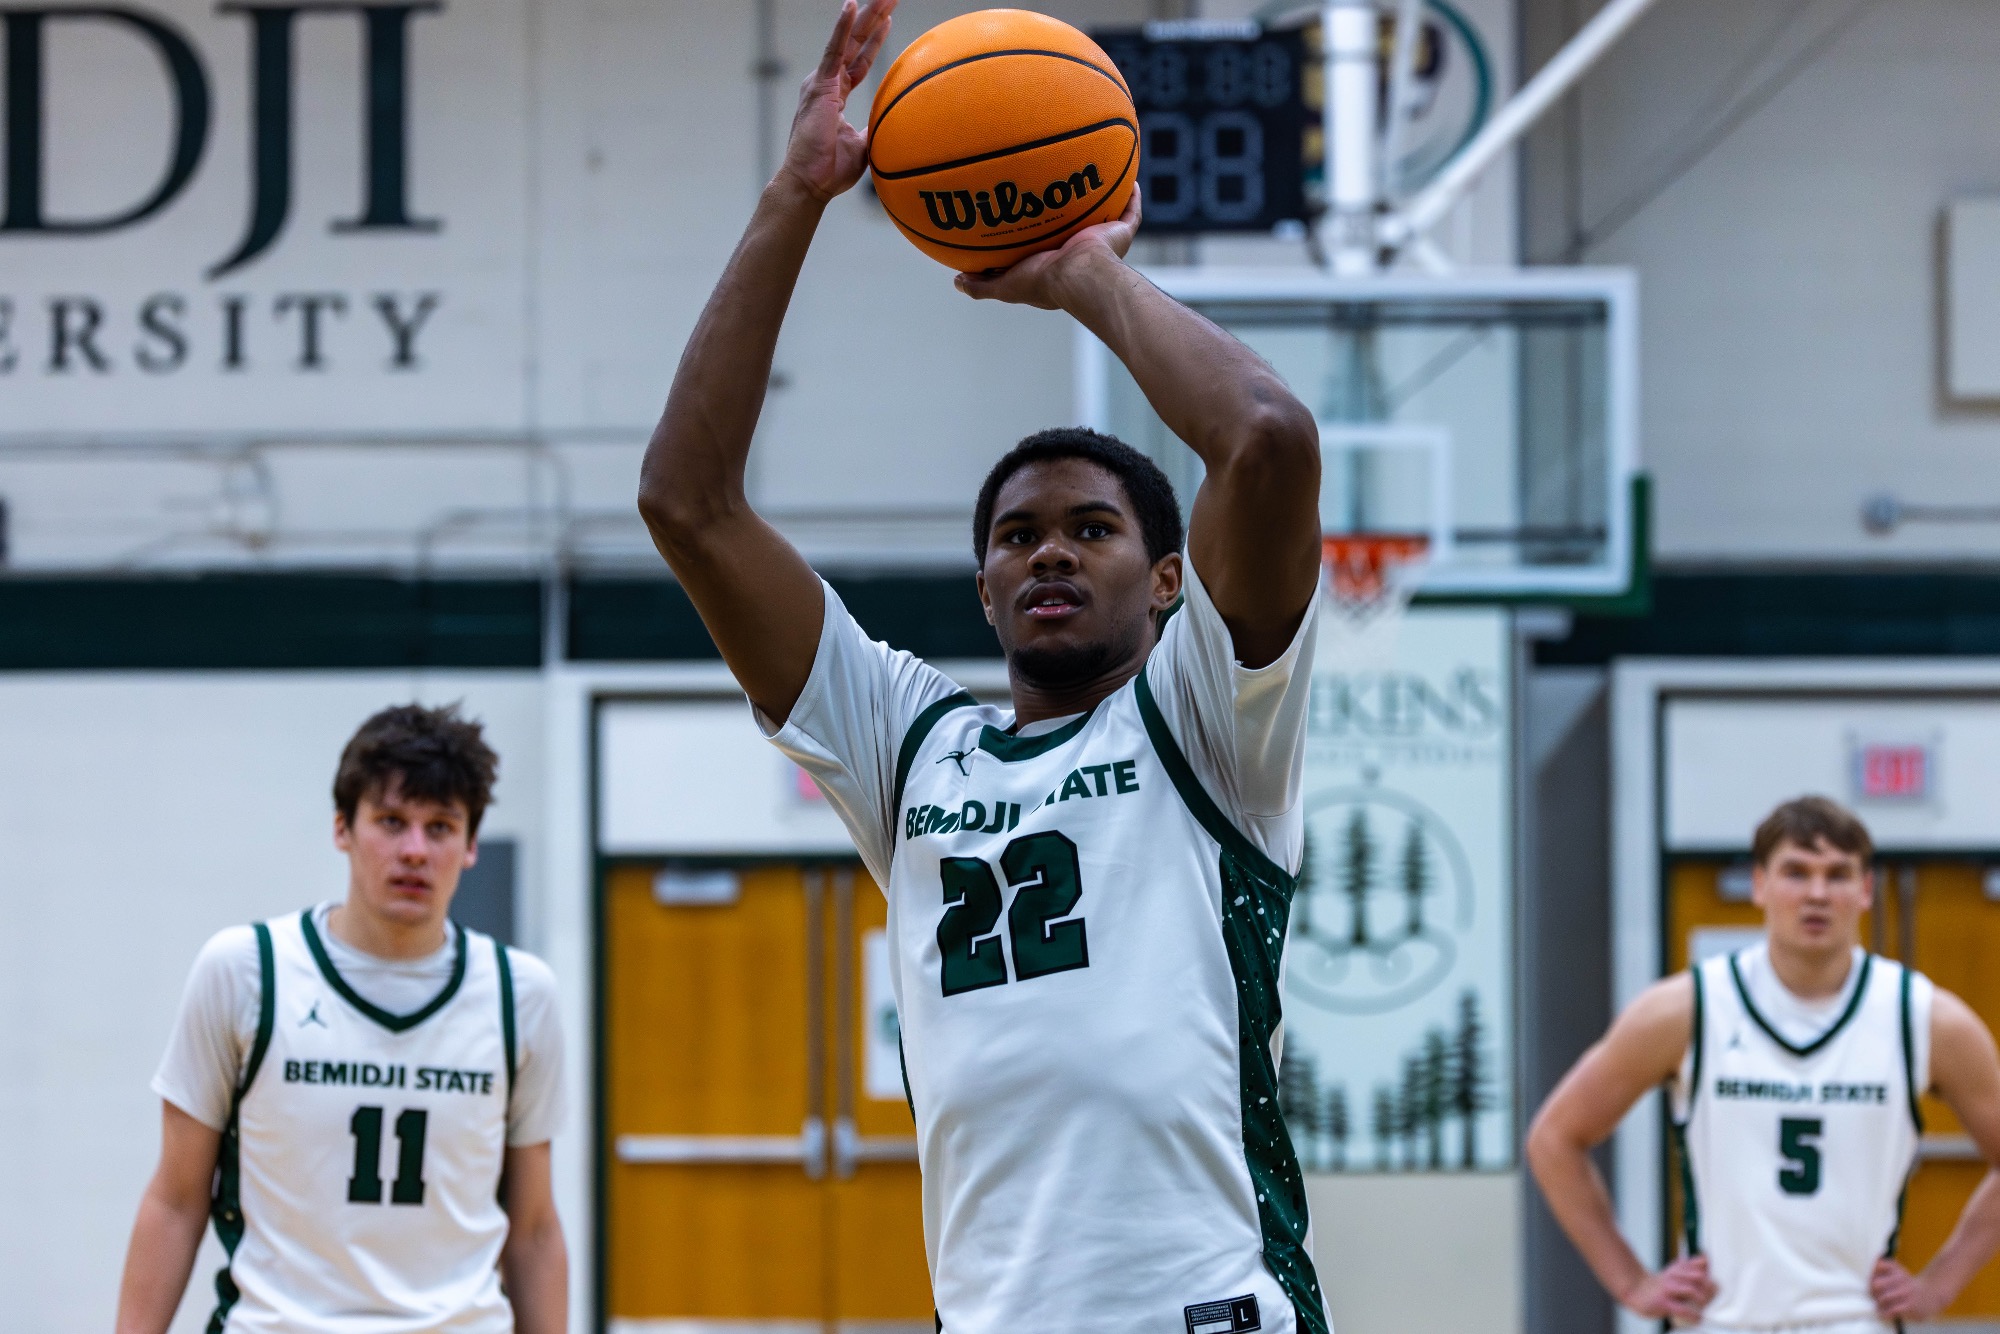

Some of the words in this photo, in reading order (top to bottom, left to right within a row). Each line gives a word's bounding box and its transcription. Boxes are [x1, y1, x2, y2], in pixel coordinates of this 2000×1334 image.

[0, 1, 443, 281] DJI
[919, 163, 1103, 230] Wilson
[980, 229, 1014, 238] INDOOR
[1016, 222, 1042, 232] GAME
[1044, 213, 1064, 224] BALL
[906, 800, 1021, 841] BEMDJI
[1030, 759, 1139, 815] ATE
[937, 829, 1089, 997] 22
[284, 1060, 406, 1089] BEMIDJI
[415, 1067, 494, 1095] STATE
[1820, 1082, 1888, 1104] STATE
[347, 1105, 428, 1206] 11
[1778, 1117, 1824, 1197] 5
[1240, 1308, 1249, 1322] L
